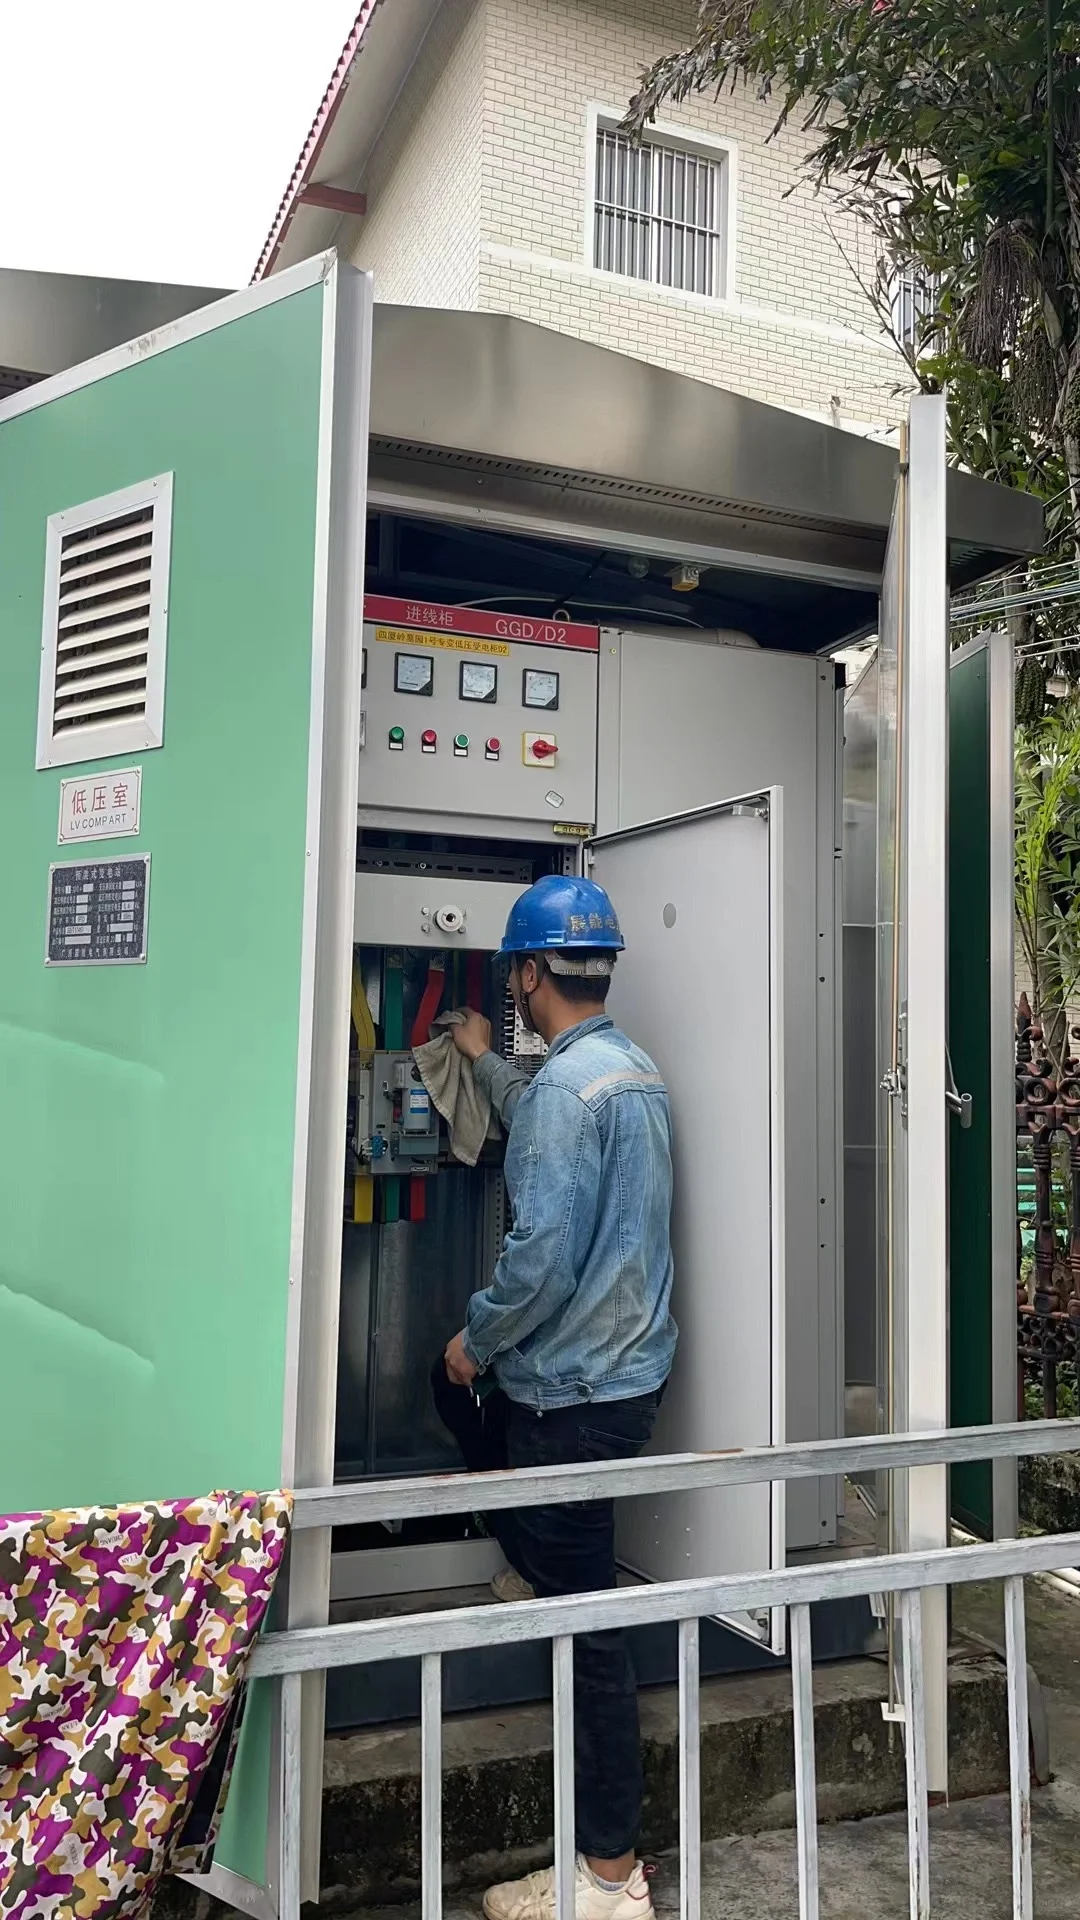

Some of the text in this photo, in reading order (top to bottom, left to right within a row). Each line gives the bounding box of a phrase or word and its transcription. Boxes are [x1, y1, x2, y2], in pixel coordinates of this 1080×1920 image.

[406, 606, 567, 644] 进线柜 GGD/D2
[72, 783, 128, 815] 低压室
